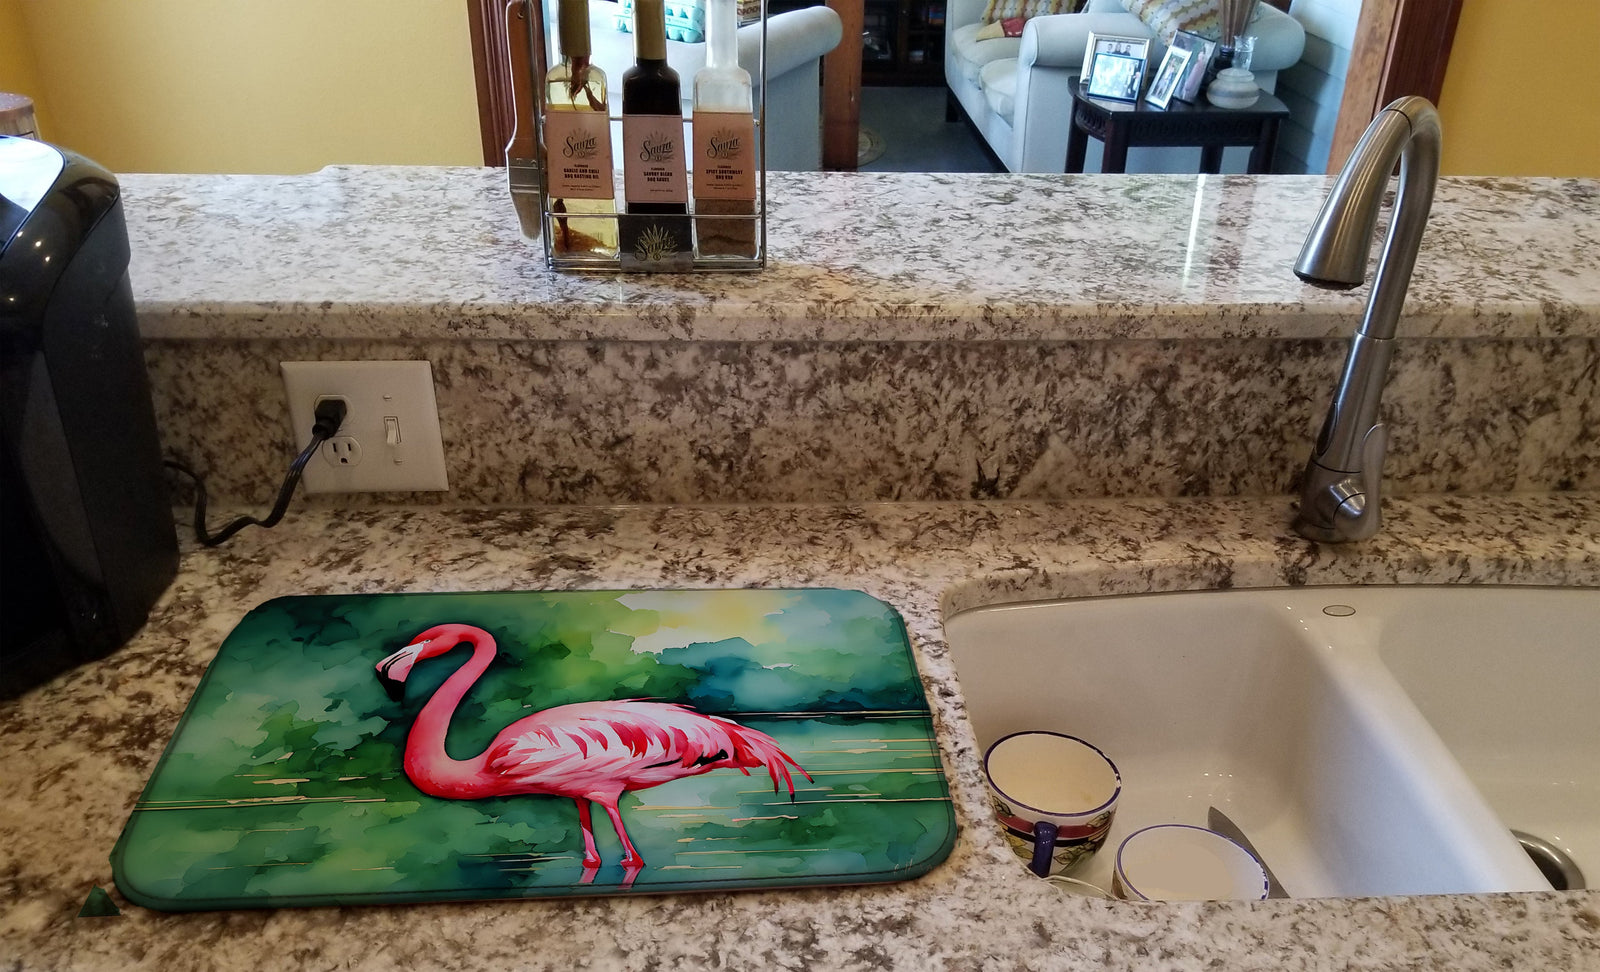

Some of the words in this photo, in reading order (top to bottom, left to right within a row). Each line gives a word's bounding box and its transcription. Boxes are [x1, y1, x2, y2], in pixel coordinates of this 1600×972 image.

[563, 136, 597, 158] Sauza
[640, 139, 673, 161] Sauza
[707, 136, 740, 158] Sauza
